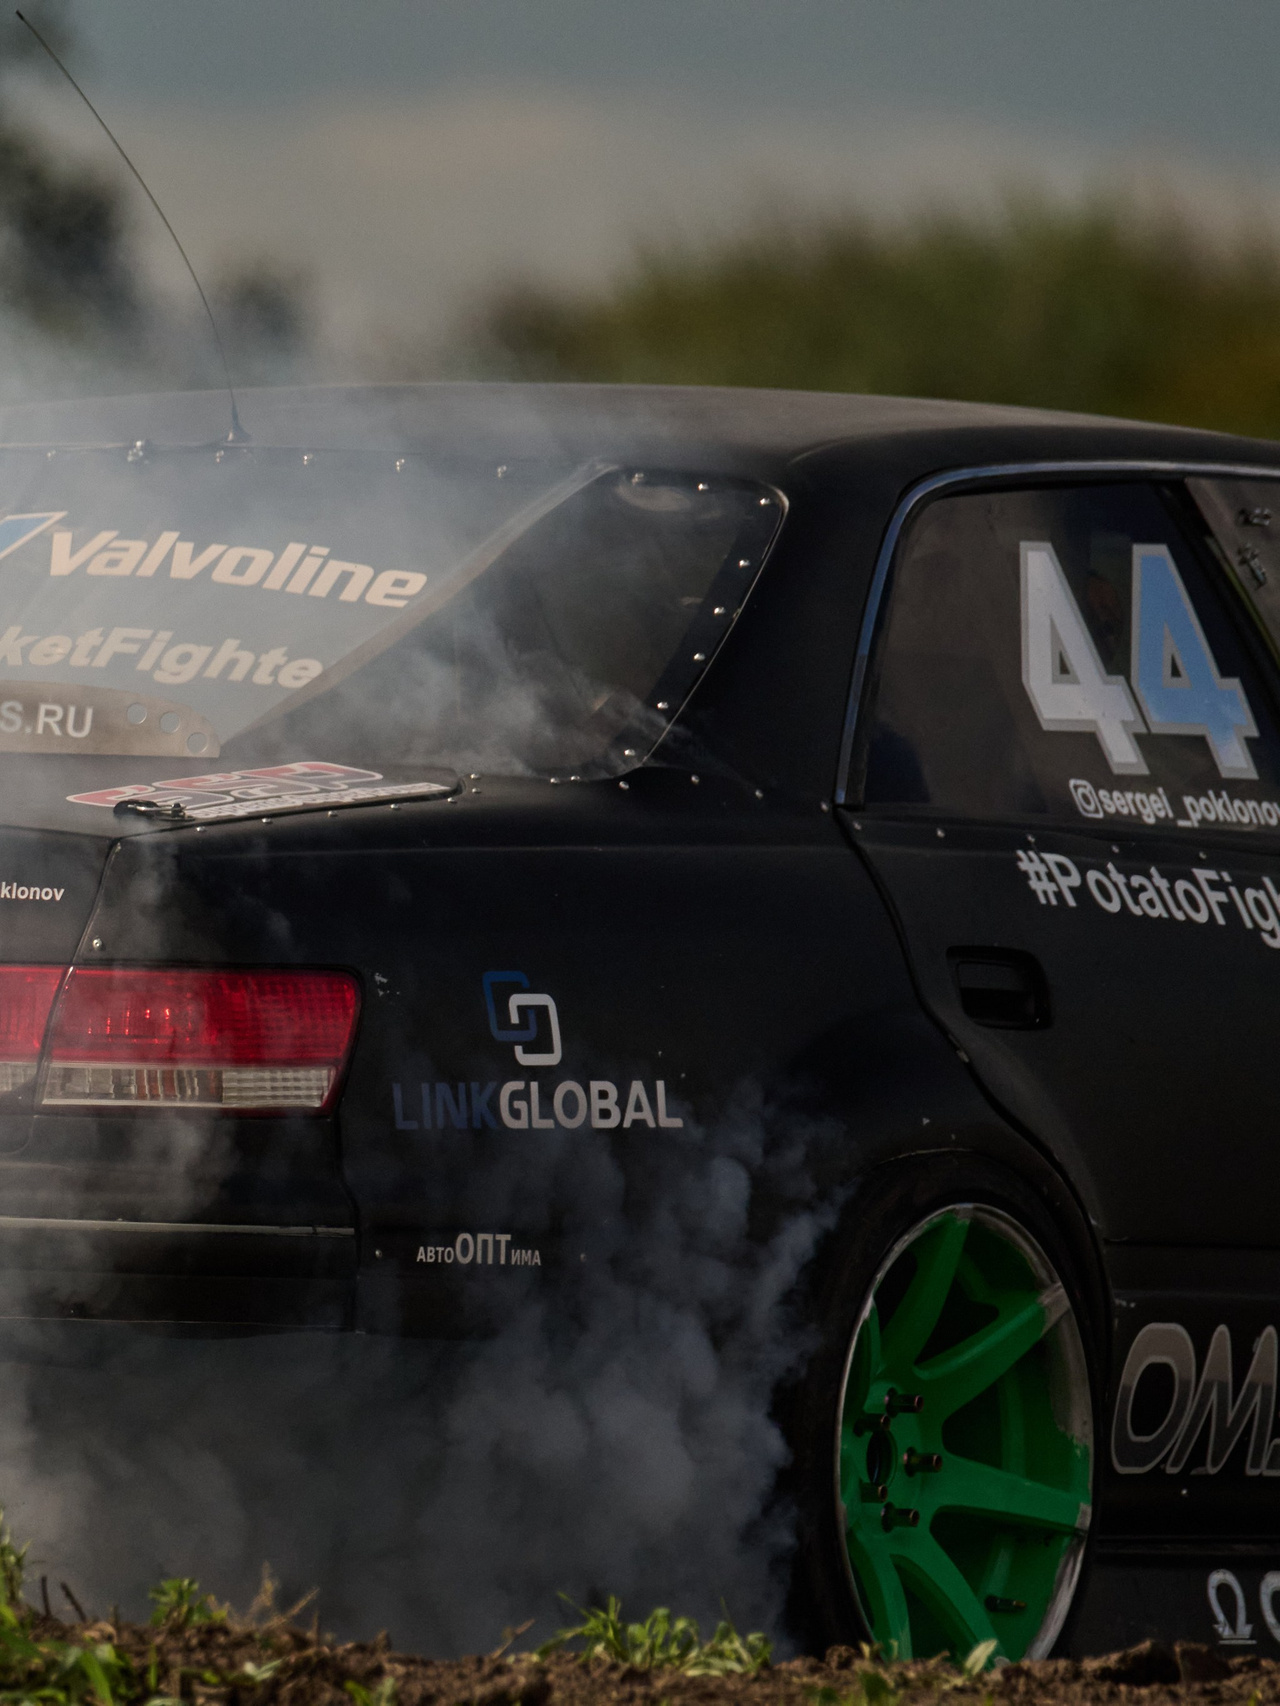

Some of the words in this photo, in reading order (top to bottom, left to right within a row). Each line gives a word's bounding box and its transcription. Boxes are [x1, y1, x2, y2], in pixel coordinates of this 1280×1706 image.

[49, 530, 428, 608] Valvoline
[1020, 540, 1261, 780] 44
[1111, 1322, 1280, 1476] OM
